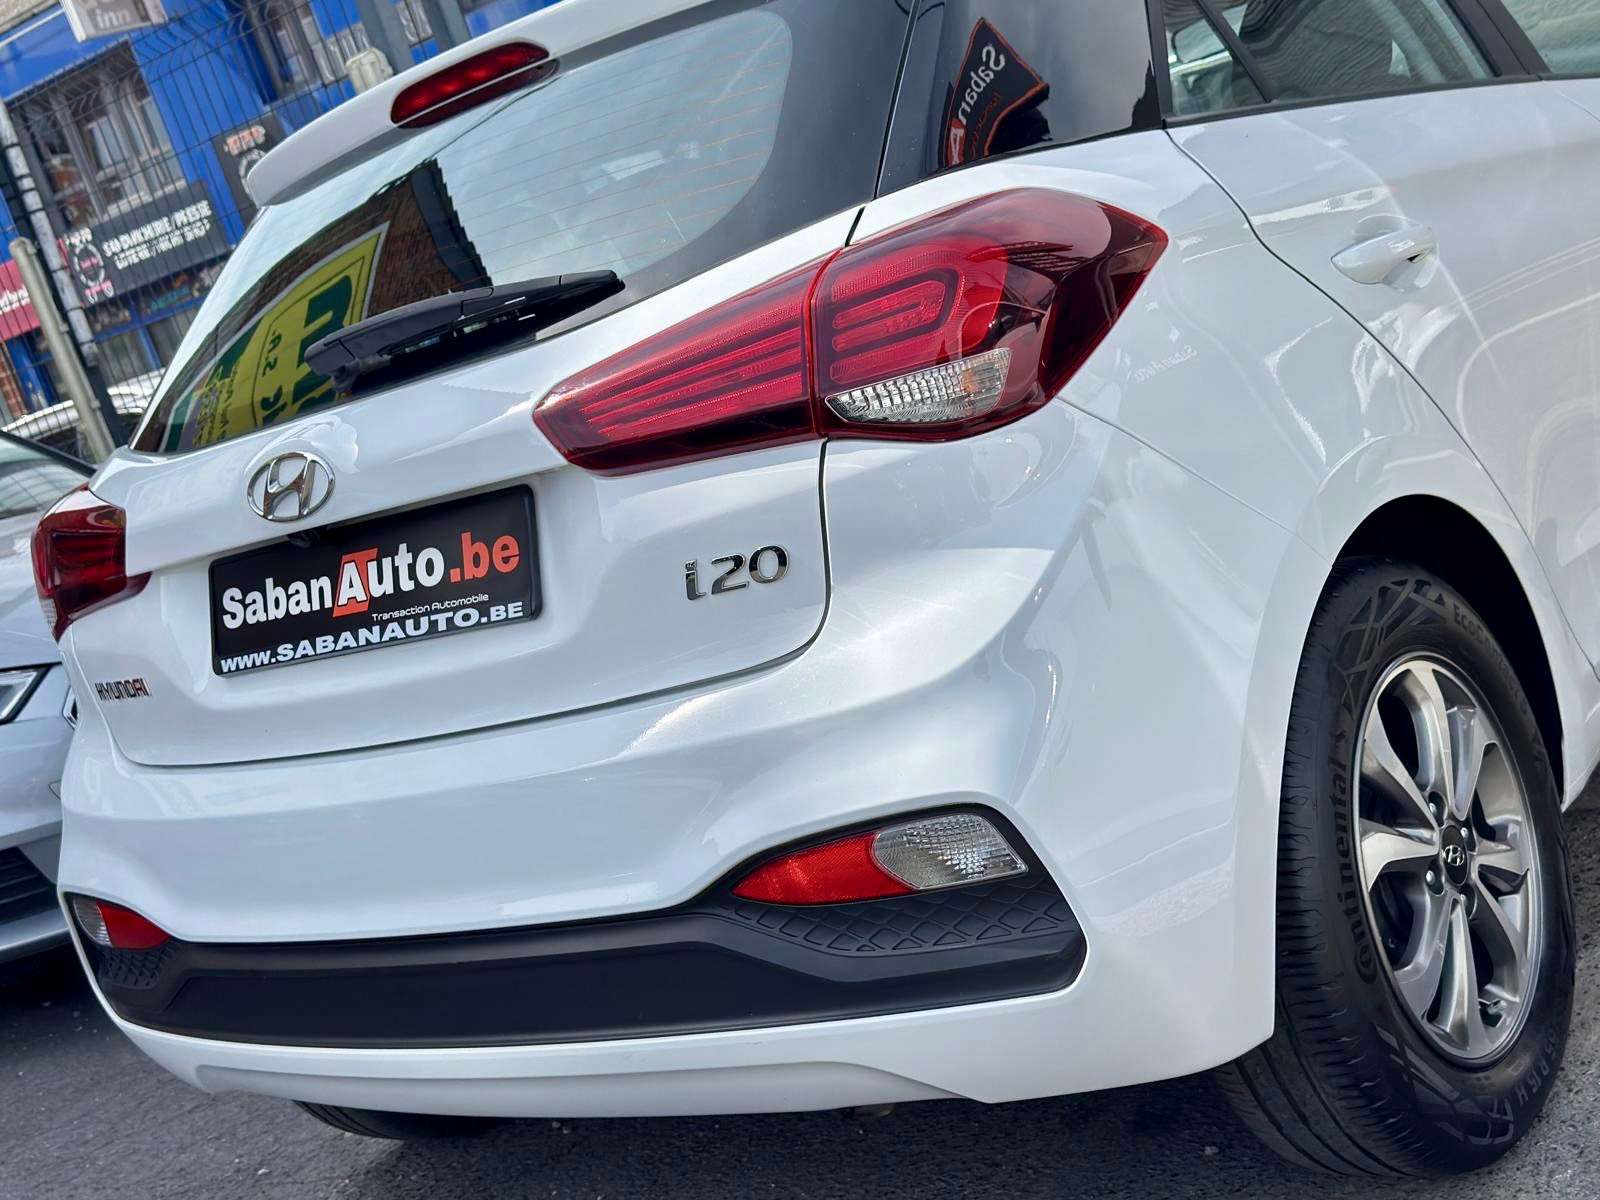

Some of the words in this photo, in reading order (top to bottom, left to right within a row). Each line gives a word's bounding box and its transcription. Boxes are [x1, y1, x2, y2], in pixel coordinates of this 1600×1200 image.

[685, 545, 789, 601] i20
[372, 604, 430, 621] Transaction
[432, 593, 489, 612] Automobile
[221, 601, 523, 674] www.SABANAUTO.BE
[95, 677, 150, 701] HYUNDAI
